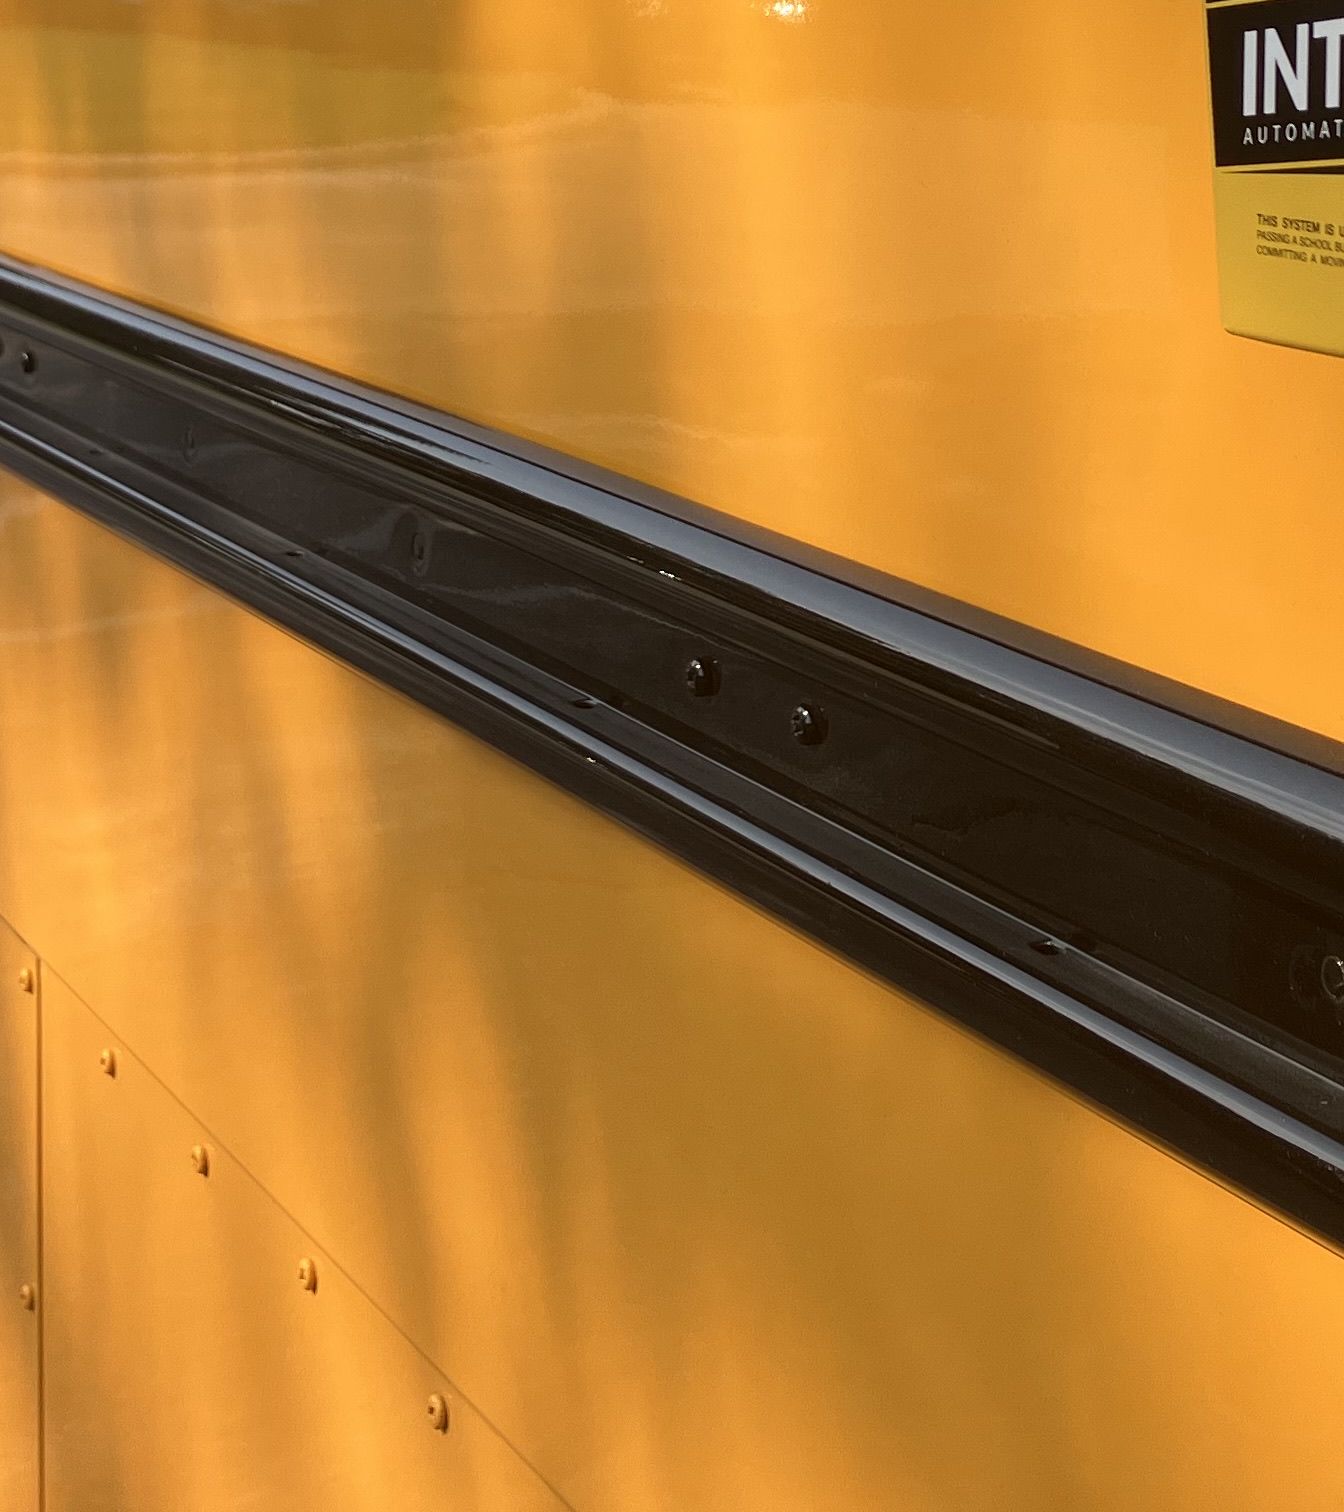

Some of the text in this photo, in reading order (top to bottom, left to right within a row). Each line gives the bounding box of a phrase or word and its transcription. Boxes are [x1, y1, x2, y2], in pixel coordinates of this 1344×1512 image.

[1256, 213, 1278, 228] THIS
[1282, 216, 1321, 234] SYSTEM
[1325, 223, 1335, 236] IS
[1299, 235, 1332, 251] SCHOOL
